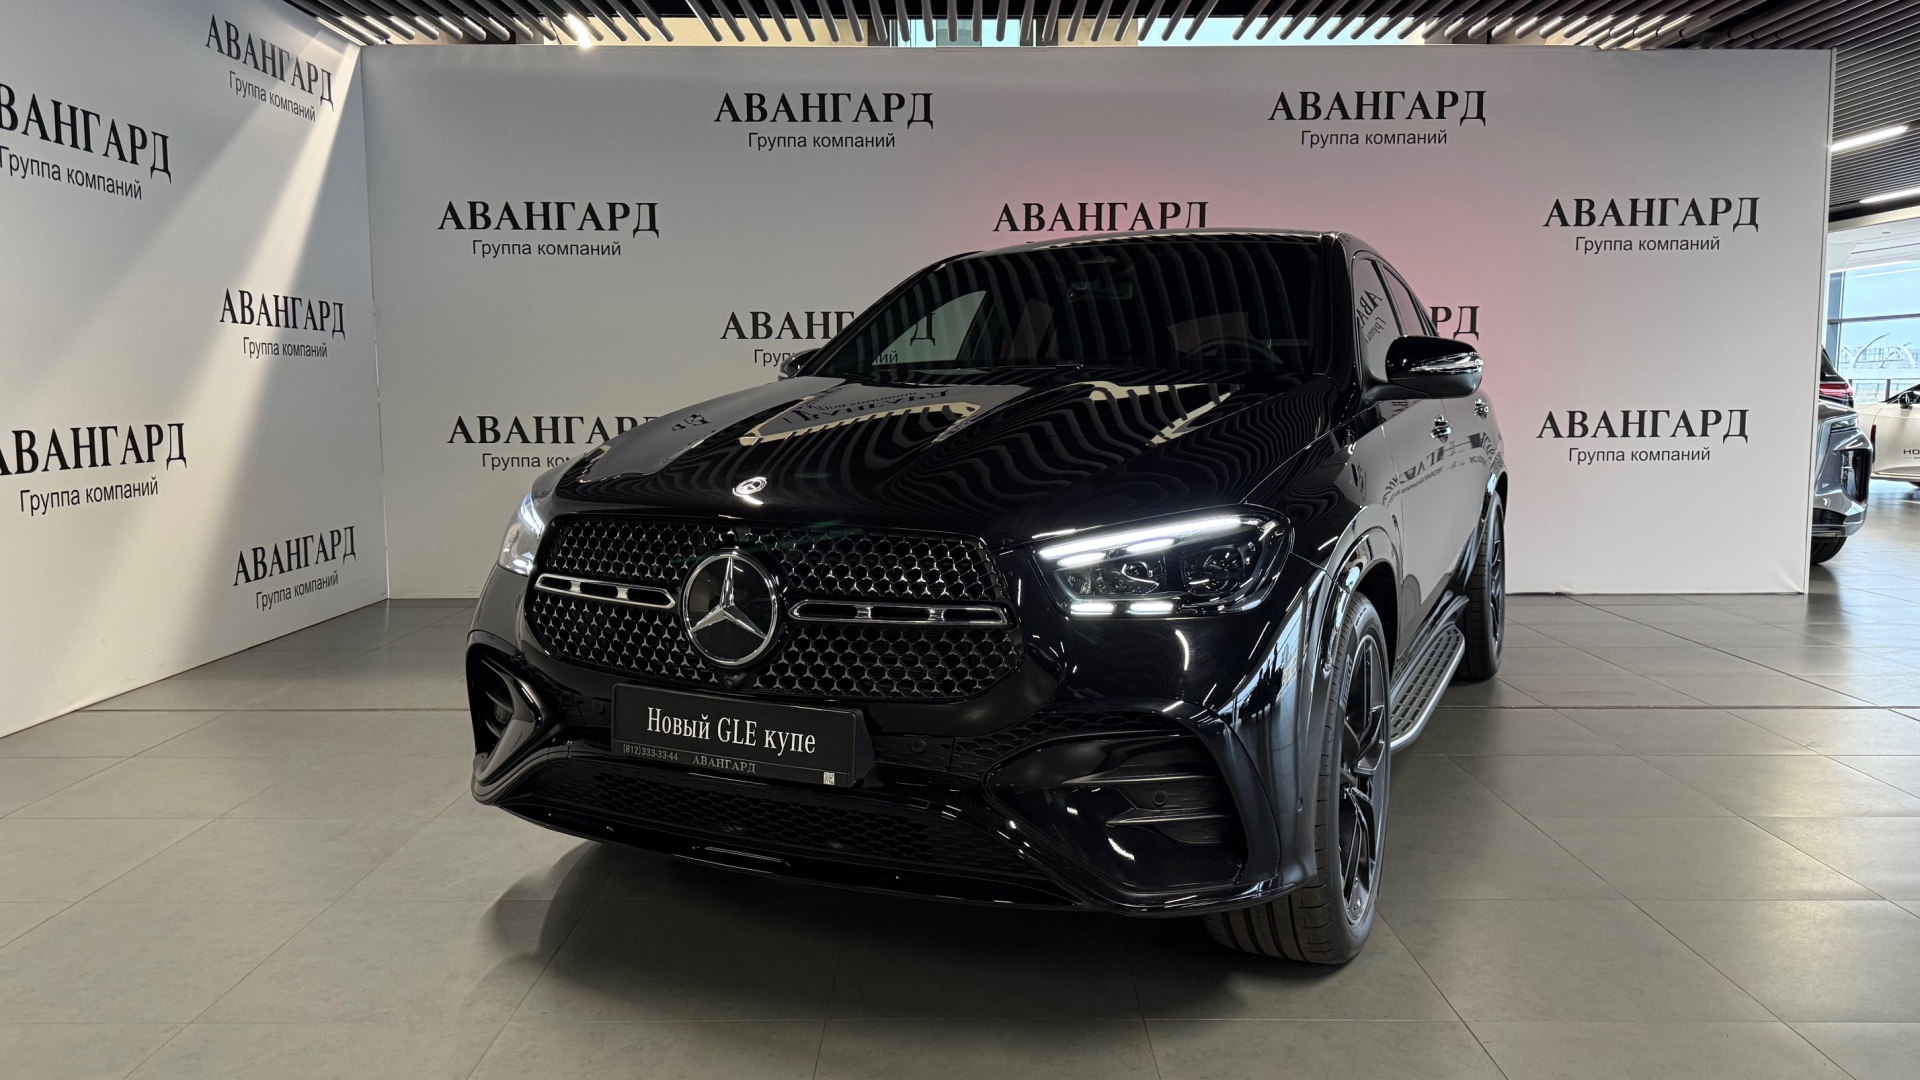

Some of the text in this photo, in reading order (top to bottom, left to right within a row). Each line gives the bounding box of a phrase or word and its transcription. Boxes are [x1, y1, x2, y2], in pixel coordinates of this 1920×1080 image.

[205, 14, 334, 111] АВАНГАРД
[229, 70, 316, 122] Группа компаний
[714, 92, 934, 130] АВАНГАРД
[1268, 90, 1487, 127] АВАНГАРД
[748, 132, 896, 151] Группа компаний
[1301, 130, 1448, 149] Группа компаний
[0, 145, 142, 200] Группа компаний
[437, 201, 660, 239] АВАНГАРД
[992, 201, 1209, 232] АВАНГАРД
[1543, 197, 1760, 233] АВАНГАРД
[472, 240, 622, 259] Группа компаний
[1575, 236, 1720, 255] Группа компаний
[220, 288, 346, 340] АВАНГАРД
[243, 337, 328, 359] Группа компаний
[447, 416, 660, 444] АВАНГАР
[1536, 409, 1750, 444] АВАНГАРД
[482, 453, 540, 470] Группа
[1568, 447, 1711, 466] Группа компаний
[20, 476, 159, 517] Группа компаний
[233, 525, 357, 587] АВАНГАРД
[255, 570, 339, 612] Группа компаний
[647, 707, 816, 756] Новый GLE купе
[692, 755, 757, 774] АВАНГАРД
